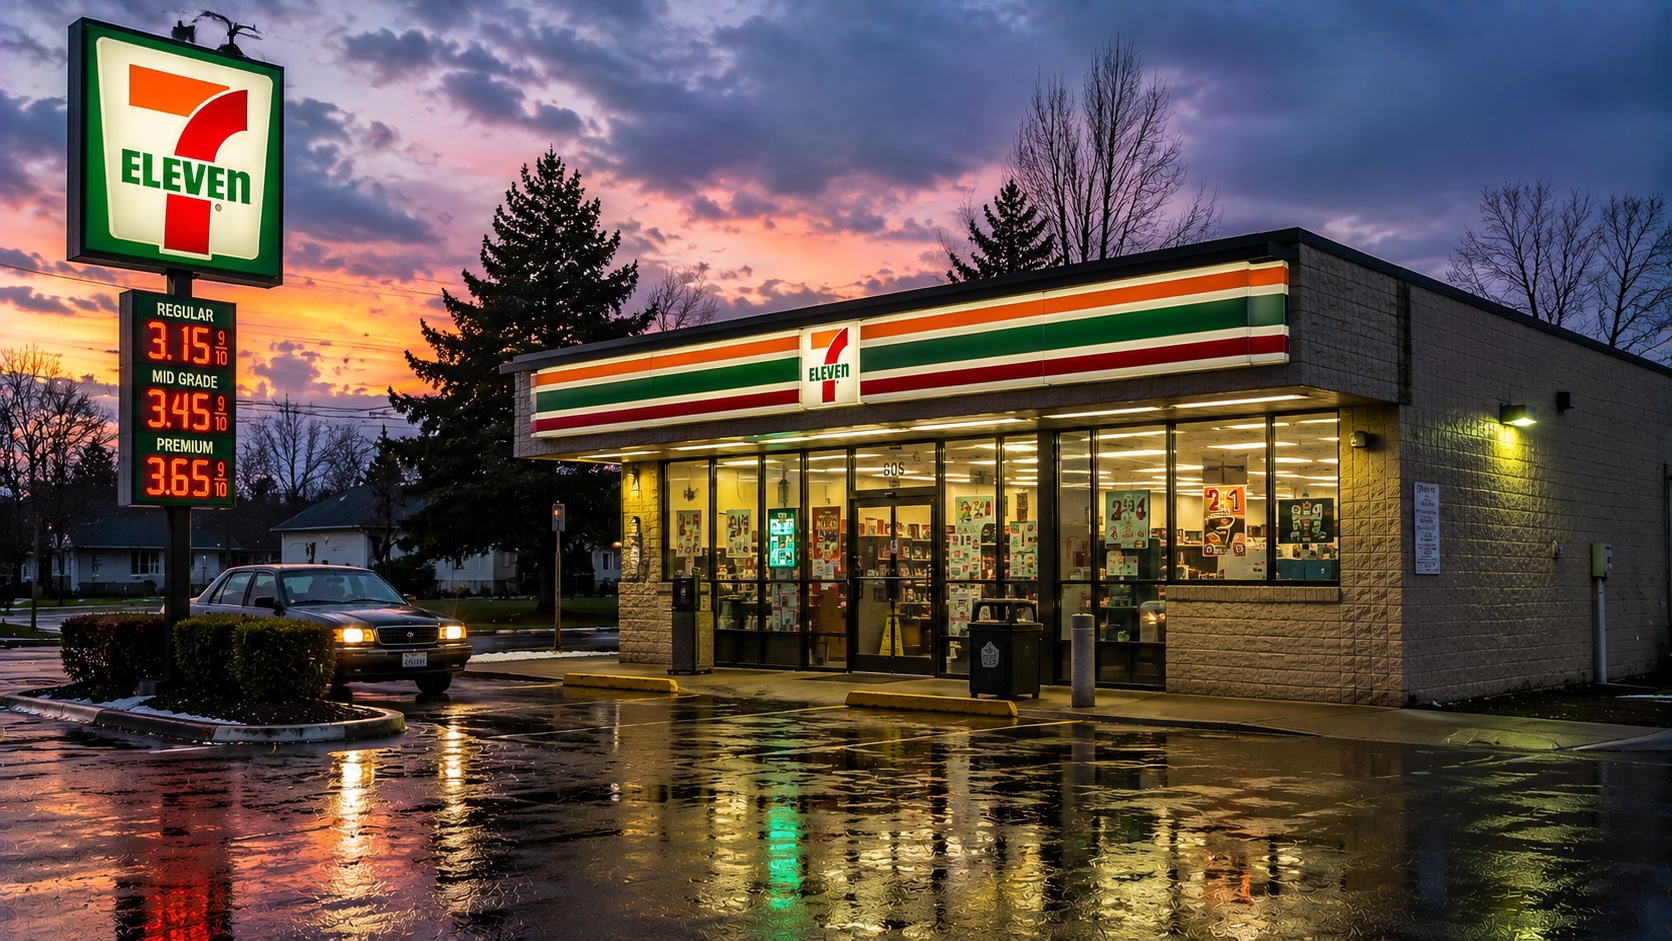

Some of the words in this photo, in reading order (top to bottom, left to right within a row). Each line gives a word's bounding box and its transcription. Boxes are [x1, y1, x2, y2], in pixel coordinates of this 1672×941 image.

[121, 148, 251, 205] ELEVEn
[129, 64, 248, 255] 7
[157, 302, 214, 322] REGULAR
[148, 321, 210, 364] 3.15
[152, 369, 175, 384] MID
[178, 372, 218, 389] GRADE
[811, 327, 848, 403] 7
[147, 389, 210, 431] 3.45
[156, 437, 214, 454] PREMIUM
[146, 457, 210, 497] 3.65
